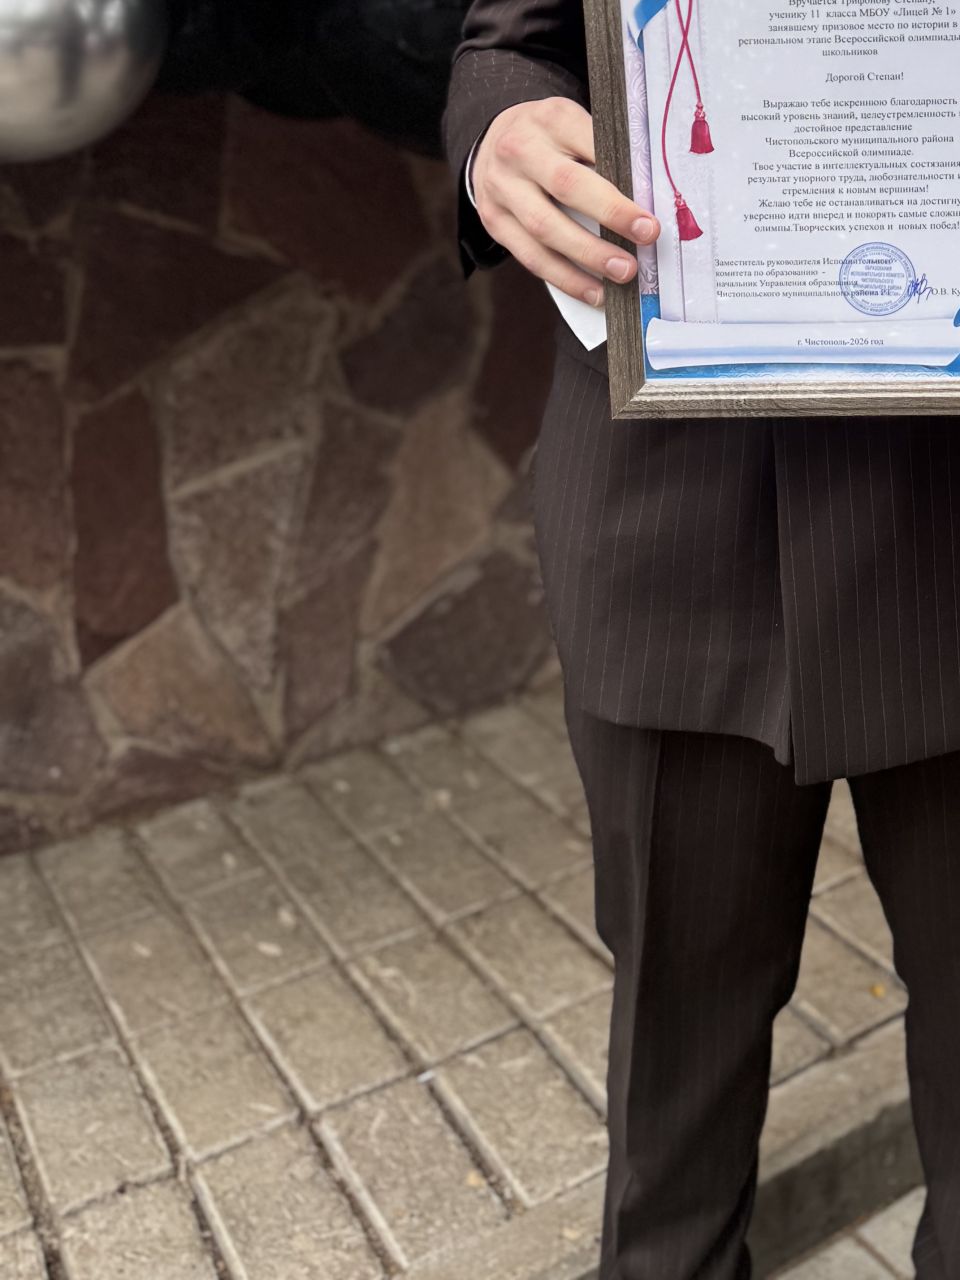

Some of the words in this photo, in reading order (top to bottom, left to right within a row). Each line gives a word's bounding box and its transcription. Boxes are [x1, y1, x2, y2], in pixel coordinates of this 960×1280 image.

[769, 12, 807, 20] ученику
[811, 10, 820, 18] 11
[860, 8, 890, 17] МБОУ
[894, 7, 928, 16] «Лицей
[946, 7, 956, 15] 1»
[768, 24, 819, 32] занявшему
[822, 23, 864, 32] призовое
[912, 22, 949, 30] истории
[738, 38, 803, 47] региональном
[834, 35, 905, 45] Всероссийской
[826, 72, 865, 83] Дорогой
[867, 72, 904, 81] Степан!
[763, 100, 808, 109] Выражаю
[812, 99, 830, 107] тебе
[834, 100, 887, 108] искреннюю
[890, 98, 957, 107] благодарность
[783, 113, 820, 122] уровень
[823, 112, 858, 120] знаний,
[861, 112, 955, 120] целеустремленность
[794, 124, 842, 133] достойное
[845, 124, 912, 133] представление
[766, 138, 838, 146] Чистопольского
[841, 137, 918, 146] муниципального
[922, 135, 954, 144] района
[789, 149, 858, 159] Всероссийской
[752, 162, 774, 170] Твое
[777, 162, 812, 172] участие
[823, 161, 907, 170] интеллектуальных
[748, 176, 790, 184] результат
[793, 175, 836, 184] упорного
[839, 175, 866, 183] труда,
[782, 188, 835, 196] стремления
[880, 185, 929, 195] вершинам!
[758, 200, 790, 208] Желаю
[793, 198, 812, 206] тебе
[744, 212, 786, 221] уверенно
[789, 212, 810, 220] идти
[812, 211, 844, 220] вперед
[855, 211, 896, 220] покорять
[849, 224, 884, 232] успехов
[930, 222, 960, 230] побед!
[767, 258, 820, 267] руководителя
[766, 269, 818, 277] образованию
[760, 280, 806, 288] Управления
[804, 337, 869, 346] Чистополь-2026
